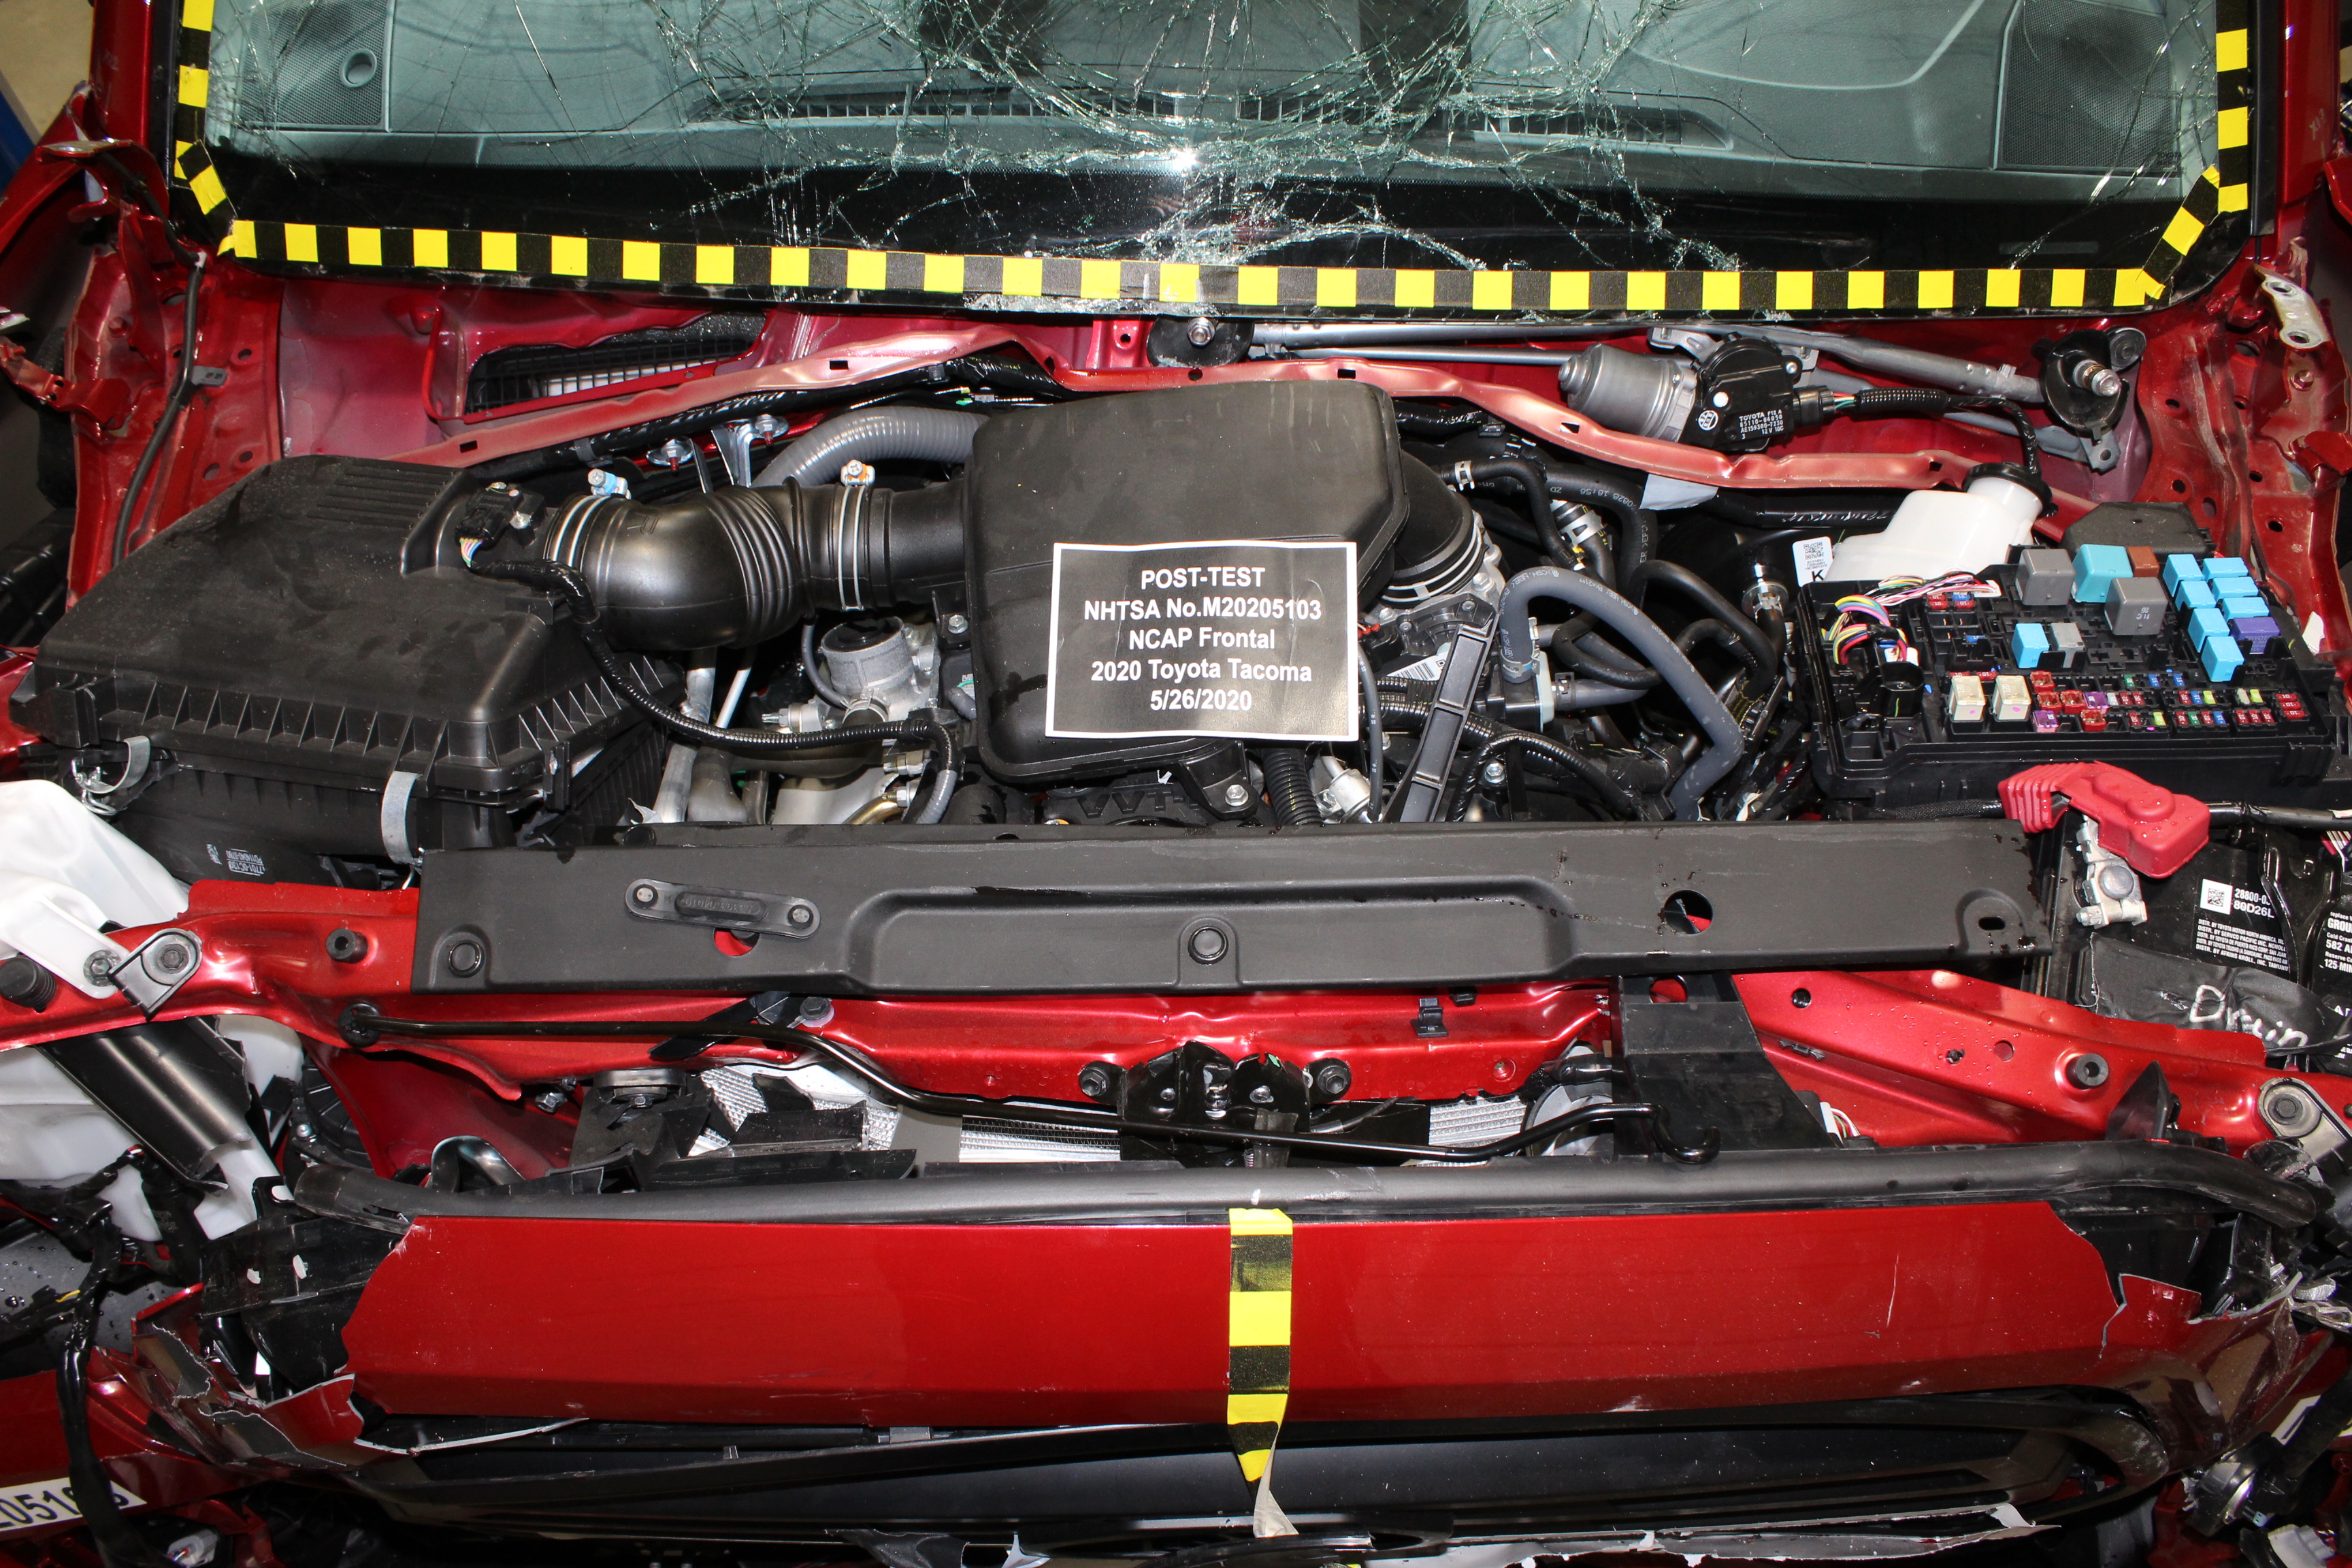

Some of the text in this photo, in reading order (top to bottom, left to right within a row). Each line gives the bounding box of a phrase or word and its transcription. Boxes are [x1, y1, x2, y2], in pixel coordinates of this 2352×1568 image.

[1739, 412, 1765, 422] TOYOTA
[1740, 414, 1783, 427] 85110-04050
[1141, 567, 1265, 589] POST-TEST
[1812, 569, 1824, 581] K
[1084, 597, 1322, 621] NHTSA No.M20205103
[1129, 627, 1275, 650] NCAP Frontal
[1091, 659, 1312, 683] 2020 Toyota Tacoma
[1150, 689, 1252, 711] 5/26/2020
[2234, 900, 2274, 919] 80D26L
[2217, 923, 2231, 932] TOYOTA
[2232, 926, 2246, 935] MOTOR
[2246, 930, 2259, 938] NORTH
[2215, 936, 2229, 945] TOYOTA
[2234, 941, 2249, 949] PUERTO
[2249, 943, 2258, 951] RICO
[2221, 931, 2239, 940] SERVCO
[2240, 935, 2258, 945] PACIFIC
[2326, 939, 2342, 951] 582
[2213, 942, 2225, 950] TOYOTA
[2221, 950, 2238, 959] ATKINS
[2325, 951, 2346, 961] Reserve
[2324, 958, 2338, 969] 125
